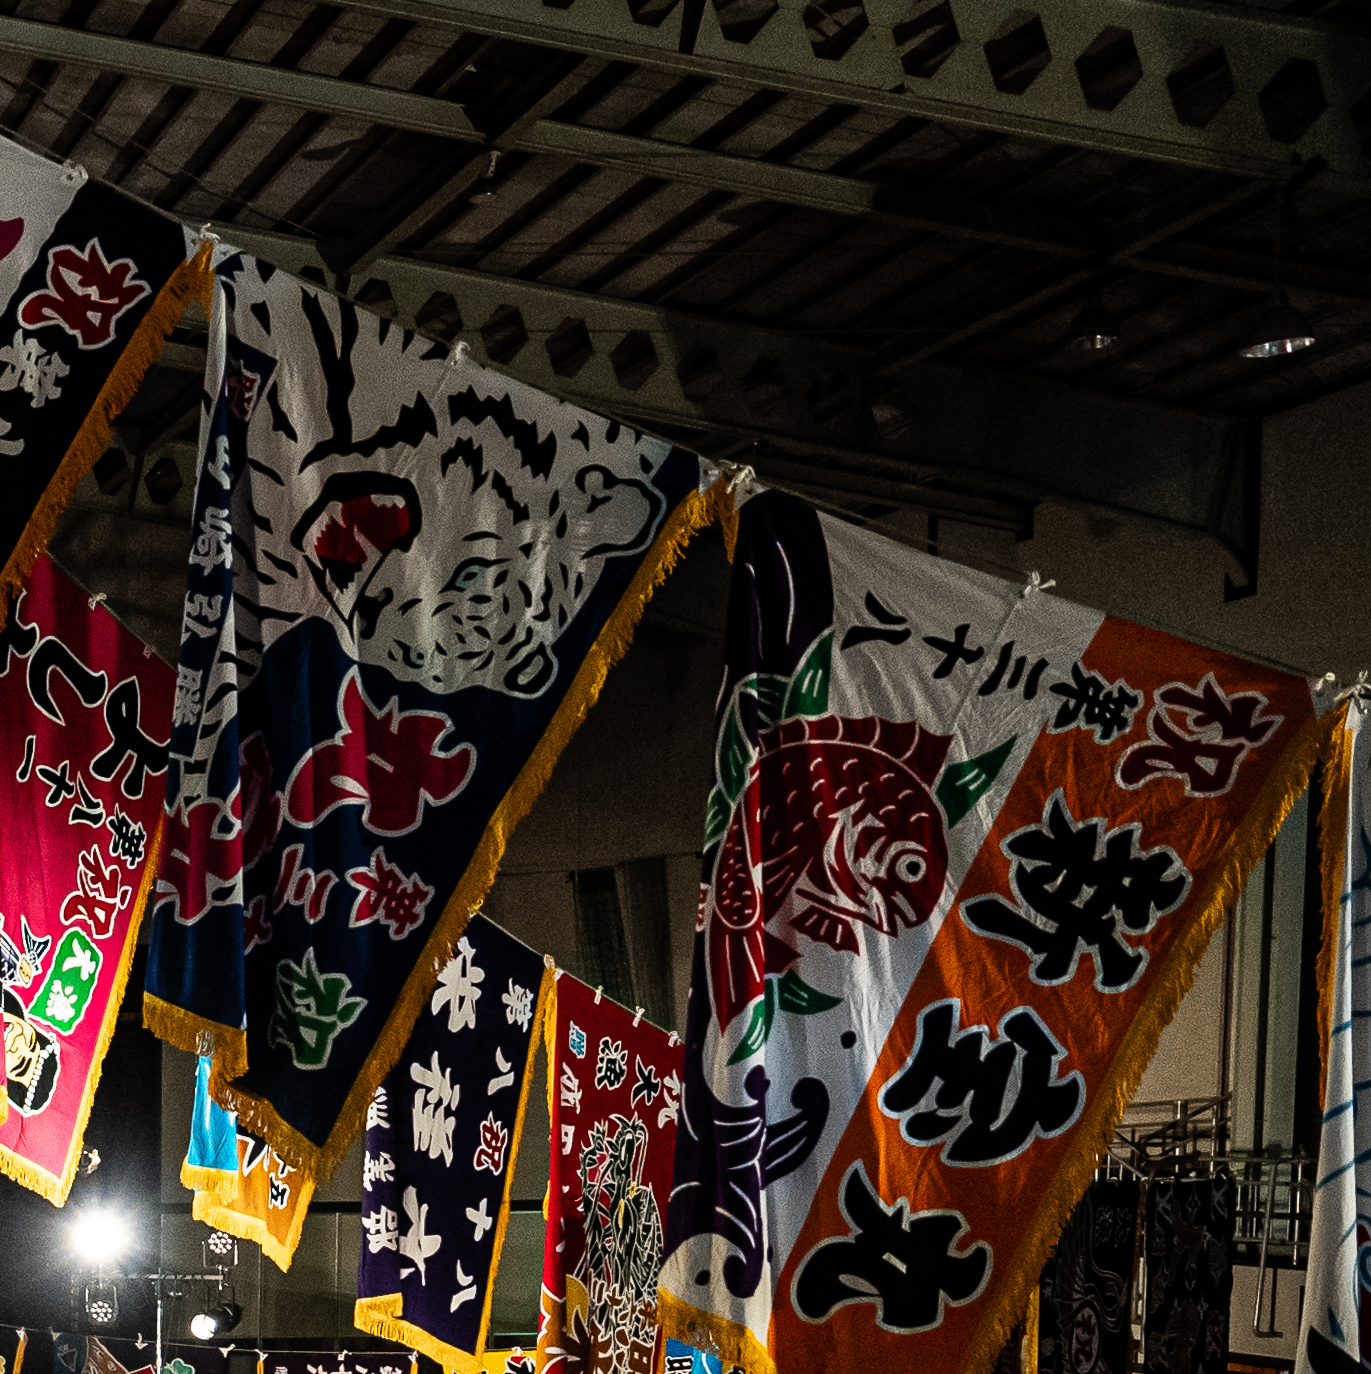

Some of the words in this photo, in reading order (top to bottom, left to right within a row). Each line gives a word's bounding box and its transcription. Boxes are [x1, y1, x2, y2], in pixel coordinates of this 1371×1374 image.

[17, 238, 152, 352] 祝
[839, 590, 1145, 742] 第三十八
[1114, 670, 1285, 797] 祝
[59, 846, 131, 940] 祝
[44, 935, 97, 1025] 大漁
[269, 946, 369, 1071] 祝
[593, 1036, 660, 1110] 大漁
[471, 1110, 508, 1176] 祝
